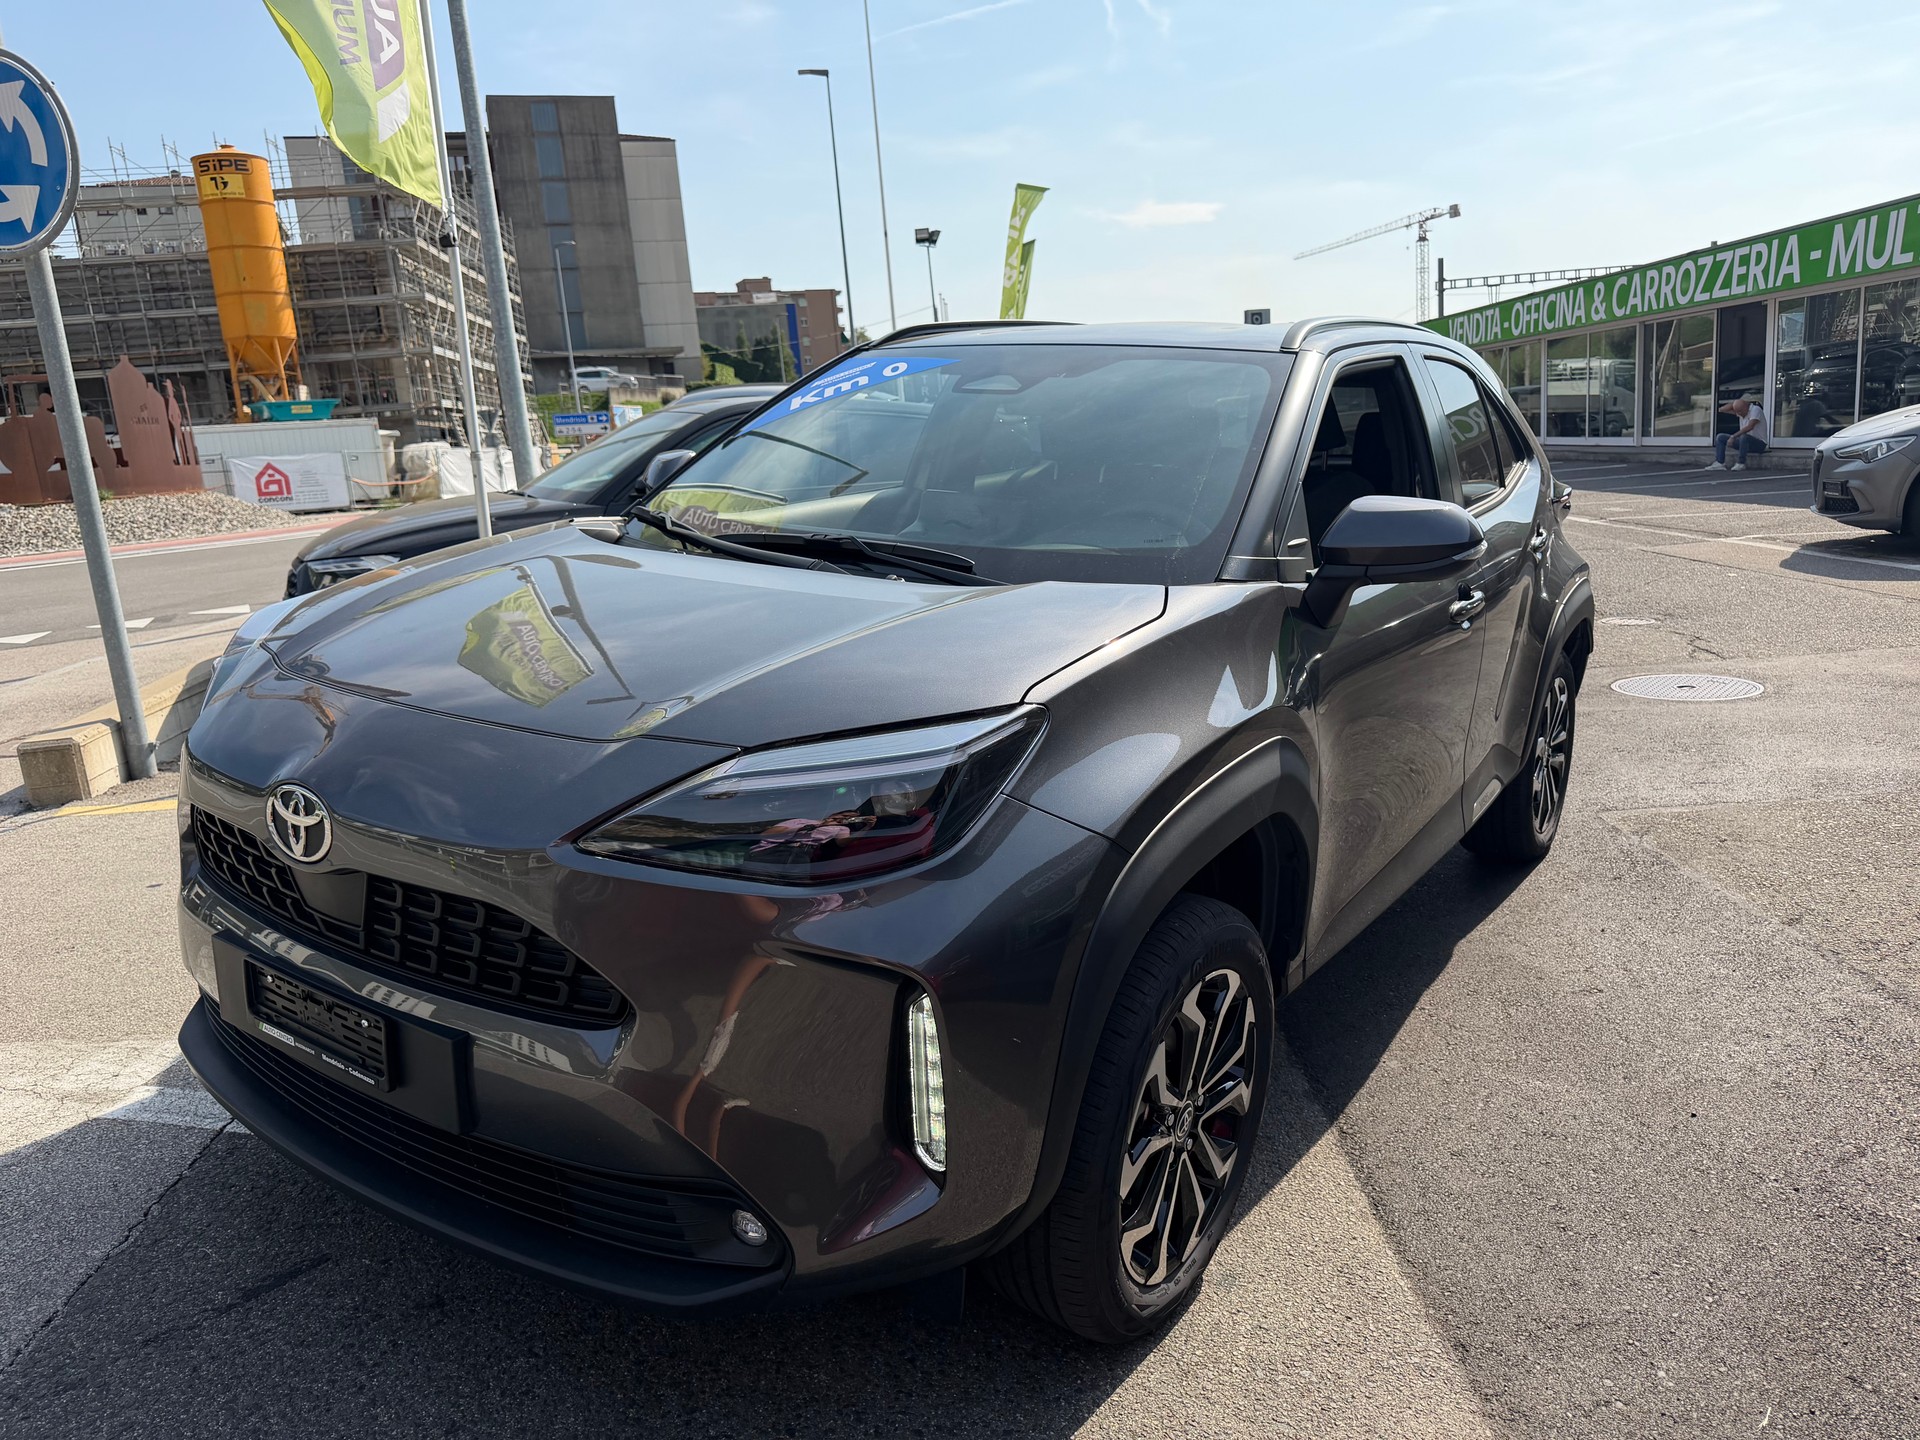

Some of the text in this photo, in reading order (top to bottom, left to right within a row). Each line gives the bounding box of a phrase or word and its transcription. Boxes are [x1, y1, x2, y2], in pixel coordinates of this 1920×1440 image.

[1448, 306, 1502, 345] VENDITA
[1511, 287, 1586, 336] OFFICINA
[1590, 281, 1607, 321] &
[1612, 234, 1801, 318] CARROZZERIA
[1826, 204, 1920, 278] MUL
[681, 508, 719, 530] AUTO
[517, 624, 542, 657] AUTO
